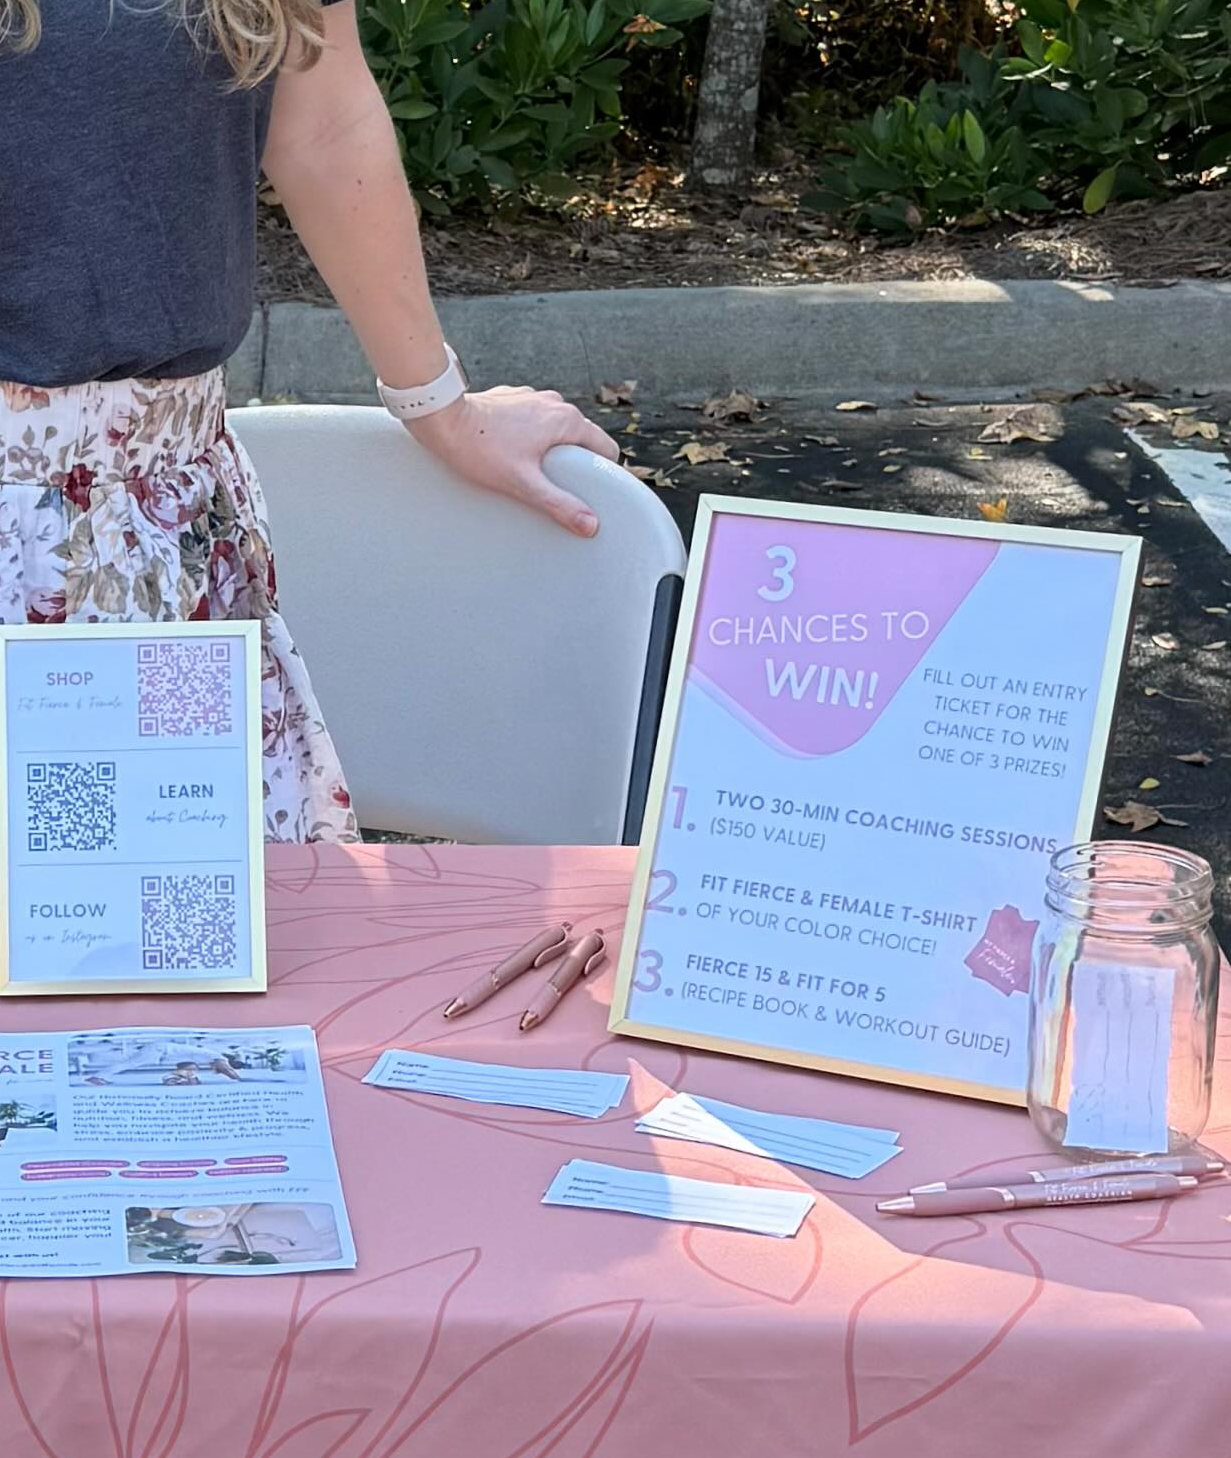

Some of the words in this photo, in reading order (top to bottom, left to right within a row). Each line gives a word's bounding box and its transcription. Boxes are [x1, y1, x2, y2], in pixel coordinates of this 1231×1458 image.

[756, 544, 797, 602] 3
[708, 612, 868, 646] CHANCES
[880, 610, 930, 640] TO
[46, 671, 94, 686] SHOP
[764, 657, 880, 710] WIN!
[923, 668, 954, 687] FILL
[961, 672, 997, 691] OUT
[1002, 677, 1028, 696] AN
[1031, 682, 1088, 703] ENTRY
[934, 695, 992, 717] TICKET
[996, 702, 1031, 722] FOR
[1038, 707, 1069, 727] THE
[923, 720, 995, 743] CHANCE
[1001, 729, 1026, 748] TO
[1032, 732, 1070, 753] WIN
[917, 745, 955, 765] ONE
[959, 749, 985, 767] OF
[989, 753, 999, 769] 3
[1003, 755, 1066, 778] PRIZES!
[159, 784, 214, 798] LEARN
[670, 785, 697, 833] 1.
[709, 816, 757, 840] ($150
[763, 825, 826, 851] VALUE)
[716, 789, 765, 812] TWO
[770, 797, 839, 823] 30-MIN
[845, 809, 955, 840] COACHING
[959, 825, 1058, 855] SESSIONS
[29, 903, 107, 918] FOLLOW
[645, 868, 687, 917] 2.
[700, 873, 727, 893] FIT
[732, 878, 797, 905] FIERCE
[800, 888, 814, 905] &
[818, 891, 895, 921] FEMALE
[901, 905, 978, 933] T-SHIRT
[695, 901, 724, 919] OF
[728, 907, 779, 930] YOUR
[784, 916, 851, 942] COLOR
[857, 928, 938, 956] CHOICE!
[632, 949, 674, 998] 3.
[686, 953, 749, 979] FIERCE
[755, 964, 772, 982] 15
[777, 969, 792, 986] &
[796, 973, 826, 992] FIT
[829, 977, 868, 1000] FOR
[874, 985, 886, 1002] 5
[680, 981, 747, 1009] (RECIPE
[752, 994, 809, 1019] BOOK
[814, 1005, 827, 1022] &
[834, 1008, 939, 1043] WORKOUT
[944, 1027, 1010, 1056] GUIDE)
